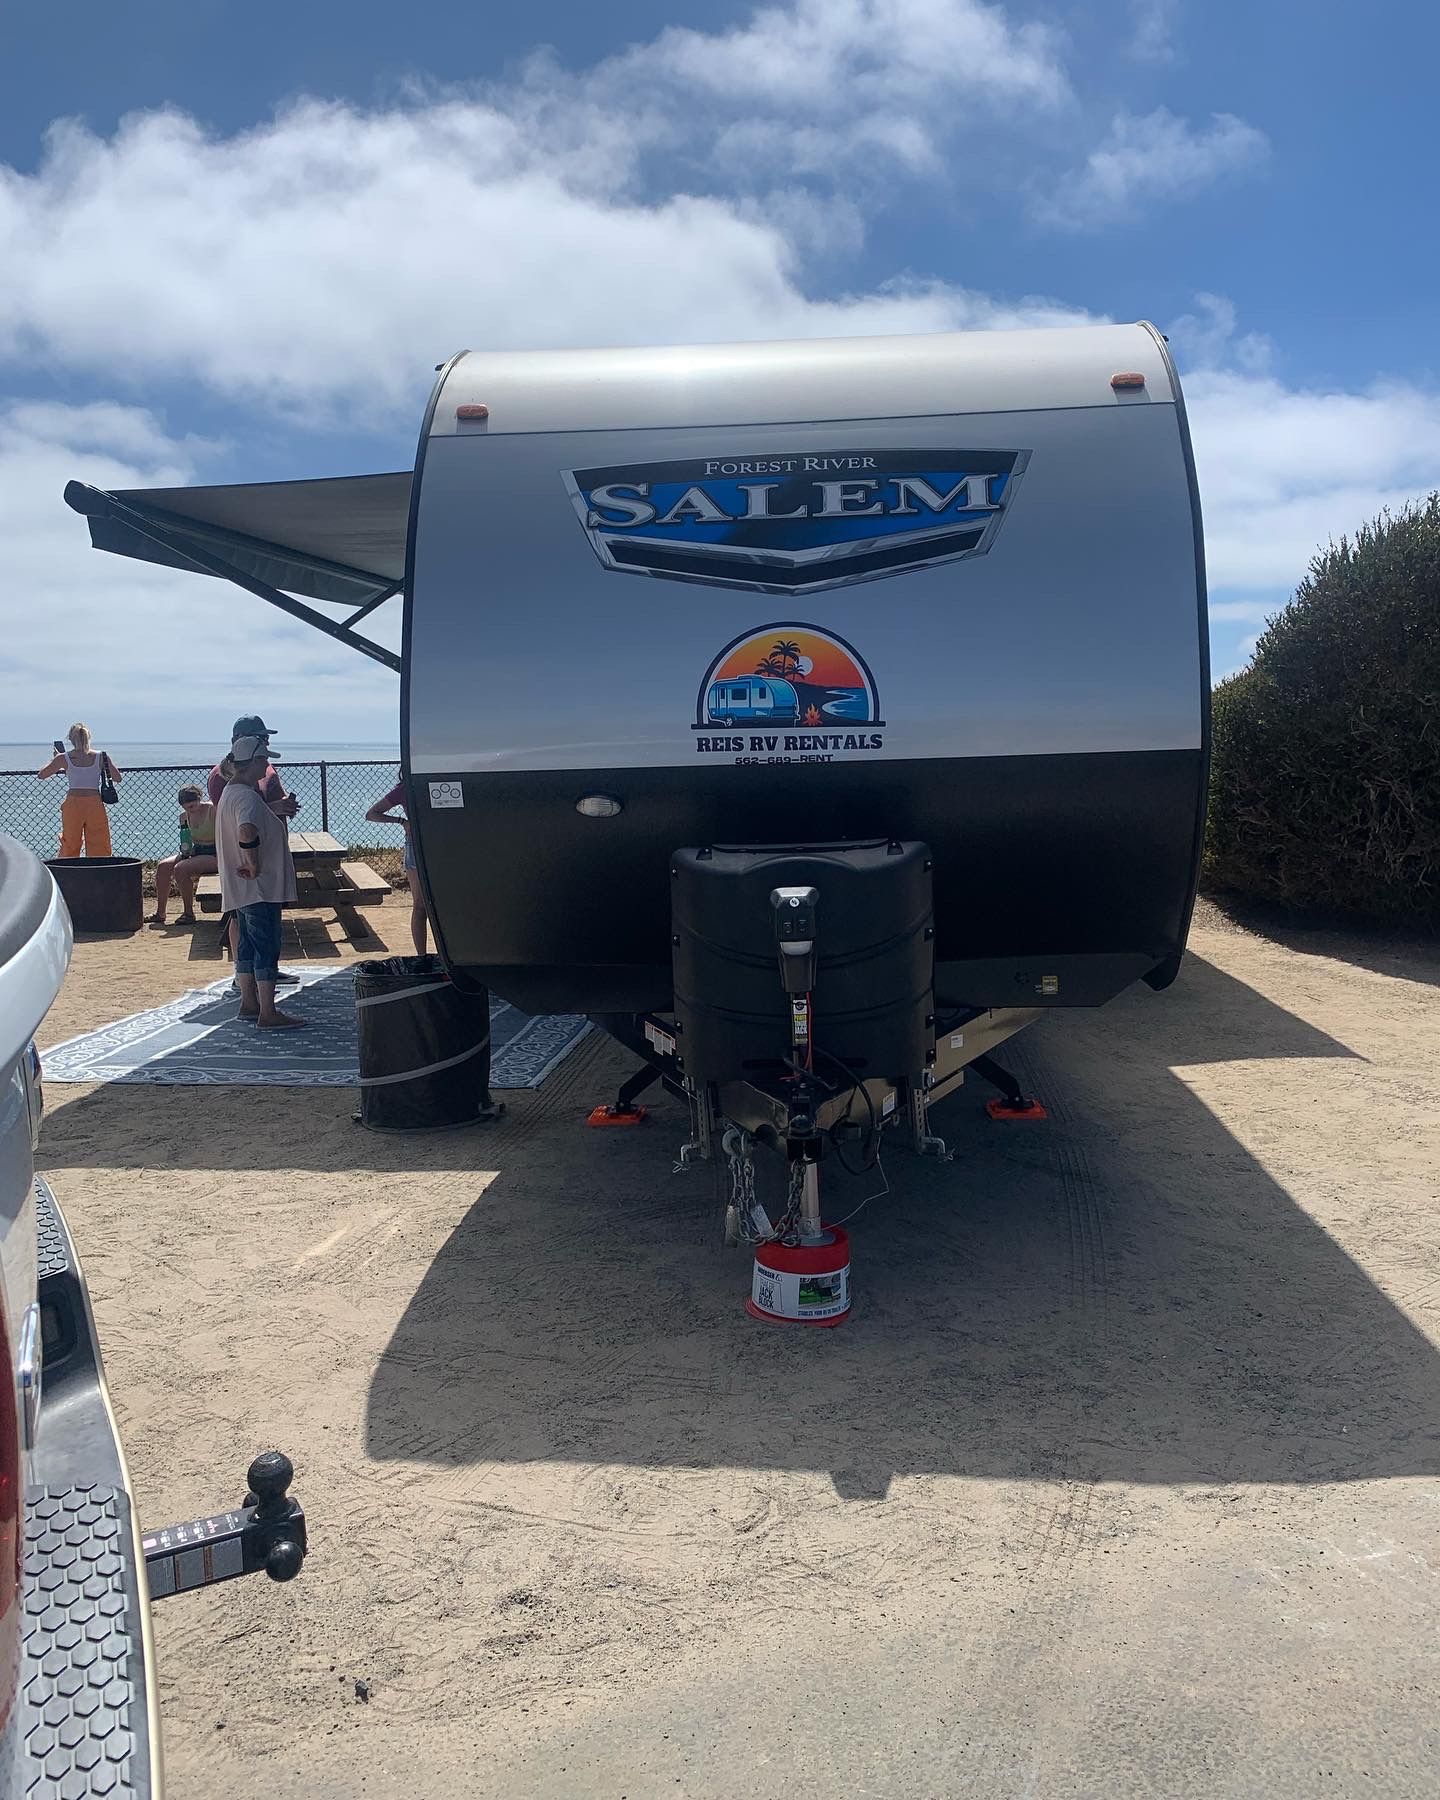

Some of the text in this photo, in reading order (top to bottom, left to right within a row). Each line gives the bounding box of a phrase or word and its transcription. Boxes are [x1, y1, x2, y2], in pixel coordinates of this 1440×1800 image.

[704, 456, 878, 475] FOREST RIVER
[588, 473, 1000, 527] SALEM
[696, 733, 883, 753] REIS RV RENTALS
[735, 754, 834, 765] 562-689-RENT
